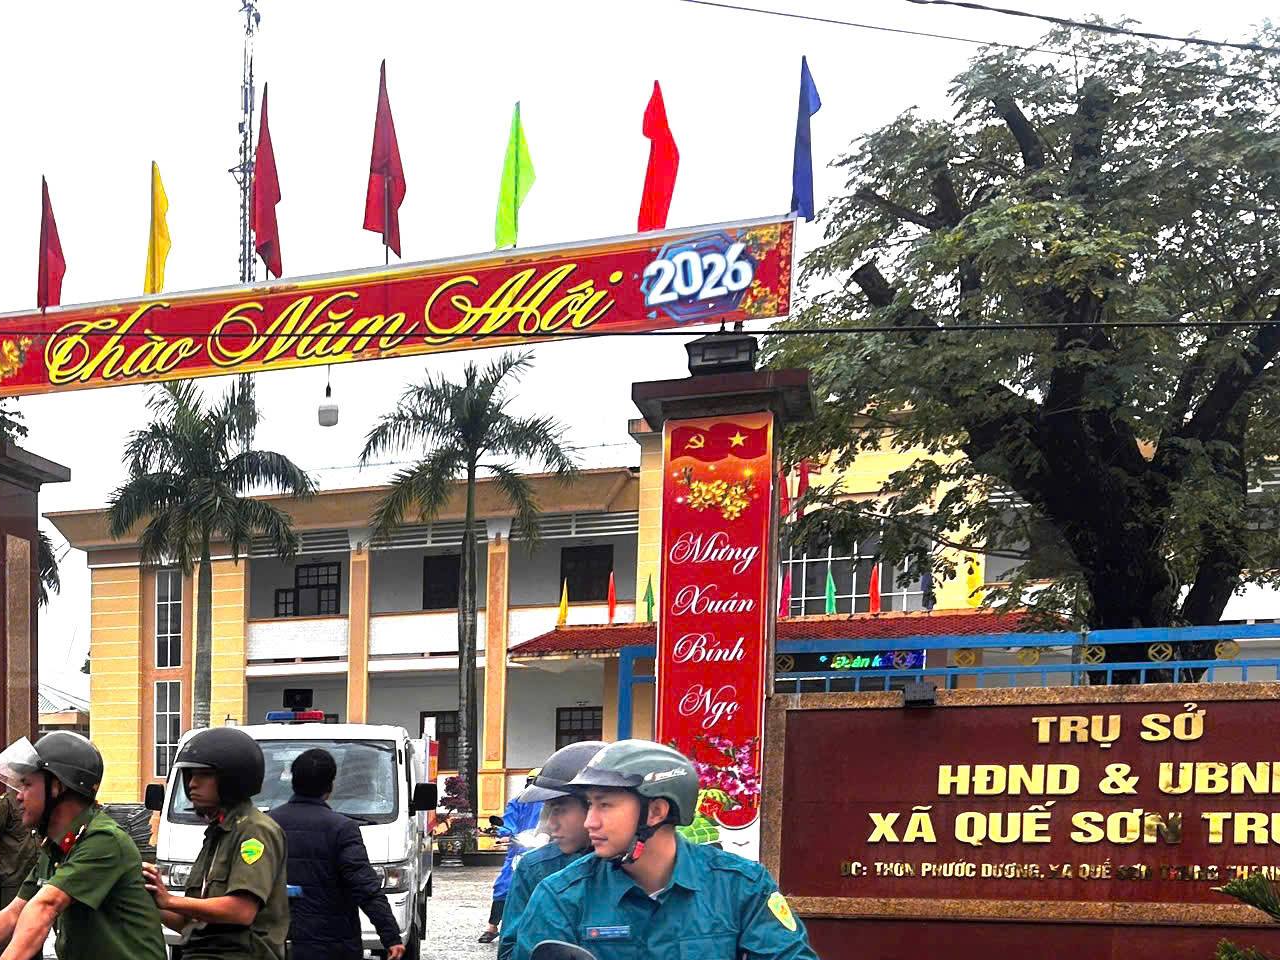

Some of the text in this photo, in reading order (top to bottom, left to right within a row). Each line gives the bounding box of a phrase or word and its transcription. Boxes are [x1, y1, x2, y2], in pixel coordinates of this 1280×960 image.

[645, 242, 757, 307] 2026
[207, 291, 420, 368] Năm
[423, 263, 623, 344] Mới
[670, 531, 760, 575] Mừng
[671, 584, 756, 616] Xuân
[673, 632, 747, 664] Bính
[678, 684, 740, 729] Ngọ
[1031, 702, 1206, 748] TRỤ SỞ
[937, 761, 1280, 795] HĐND & UBN
[867, 800, 1280, 846] XÃ QUẾ SƠN TR
